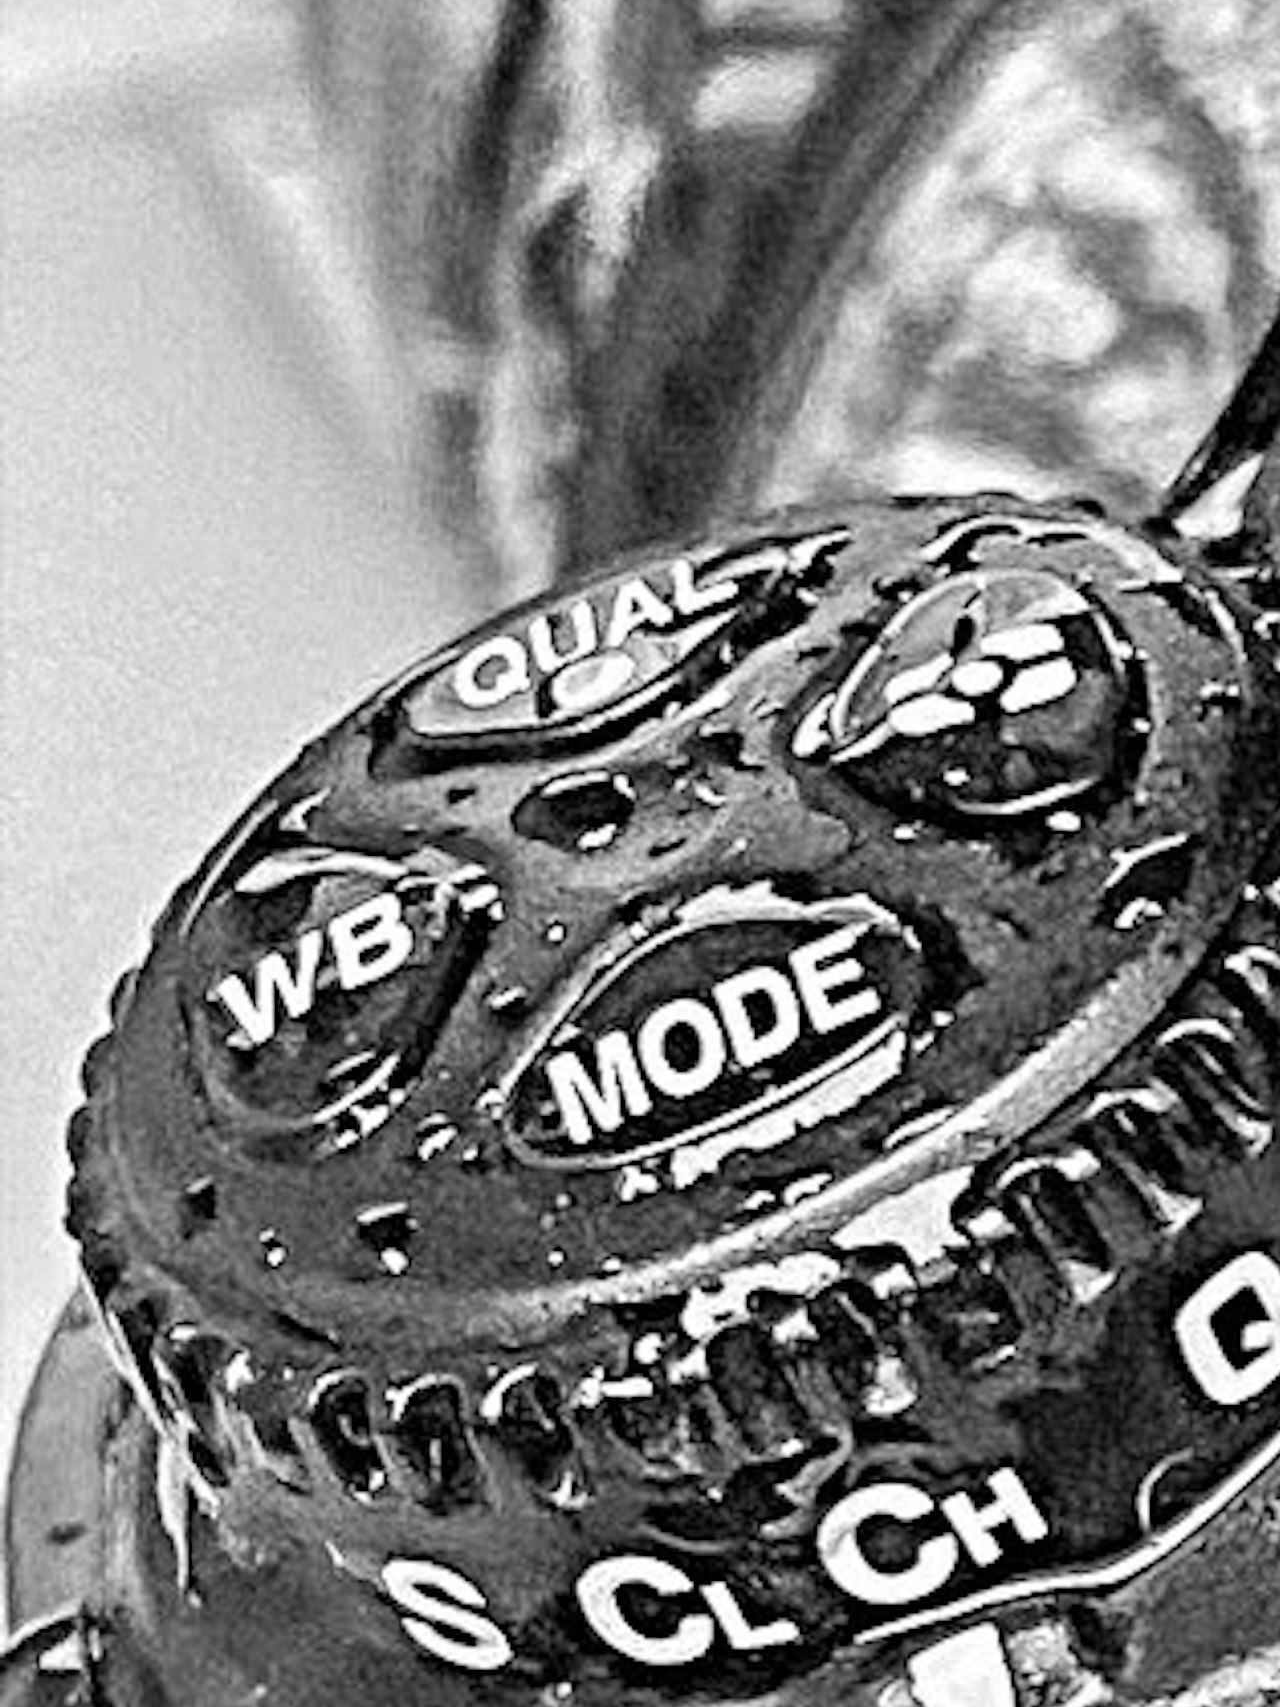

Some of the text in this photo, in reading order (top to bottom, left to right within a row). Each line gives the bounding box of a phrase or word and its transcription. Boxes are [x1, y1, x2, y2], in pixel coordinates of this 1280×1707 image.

[453, 558, 738, 710] QUAL
[206, 894, 414, 1050] WB
[545, 932, 882, 1145] MODE
[383, 1560, 511, 1669] S
[576, 1555, 800, 1666] CL
[815, 1467, 1050, 1605] CH
